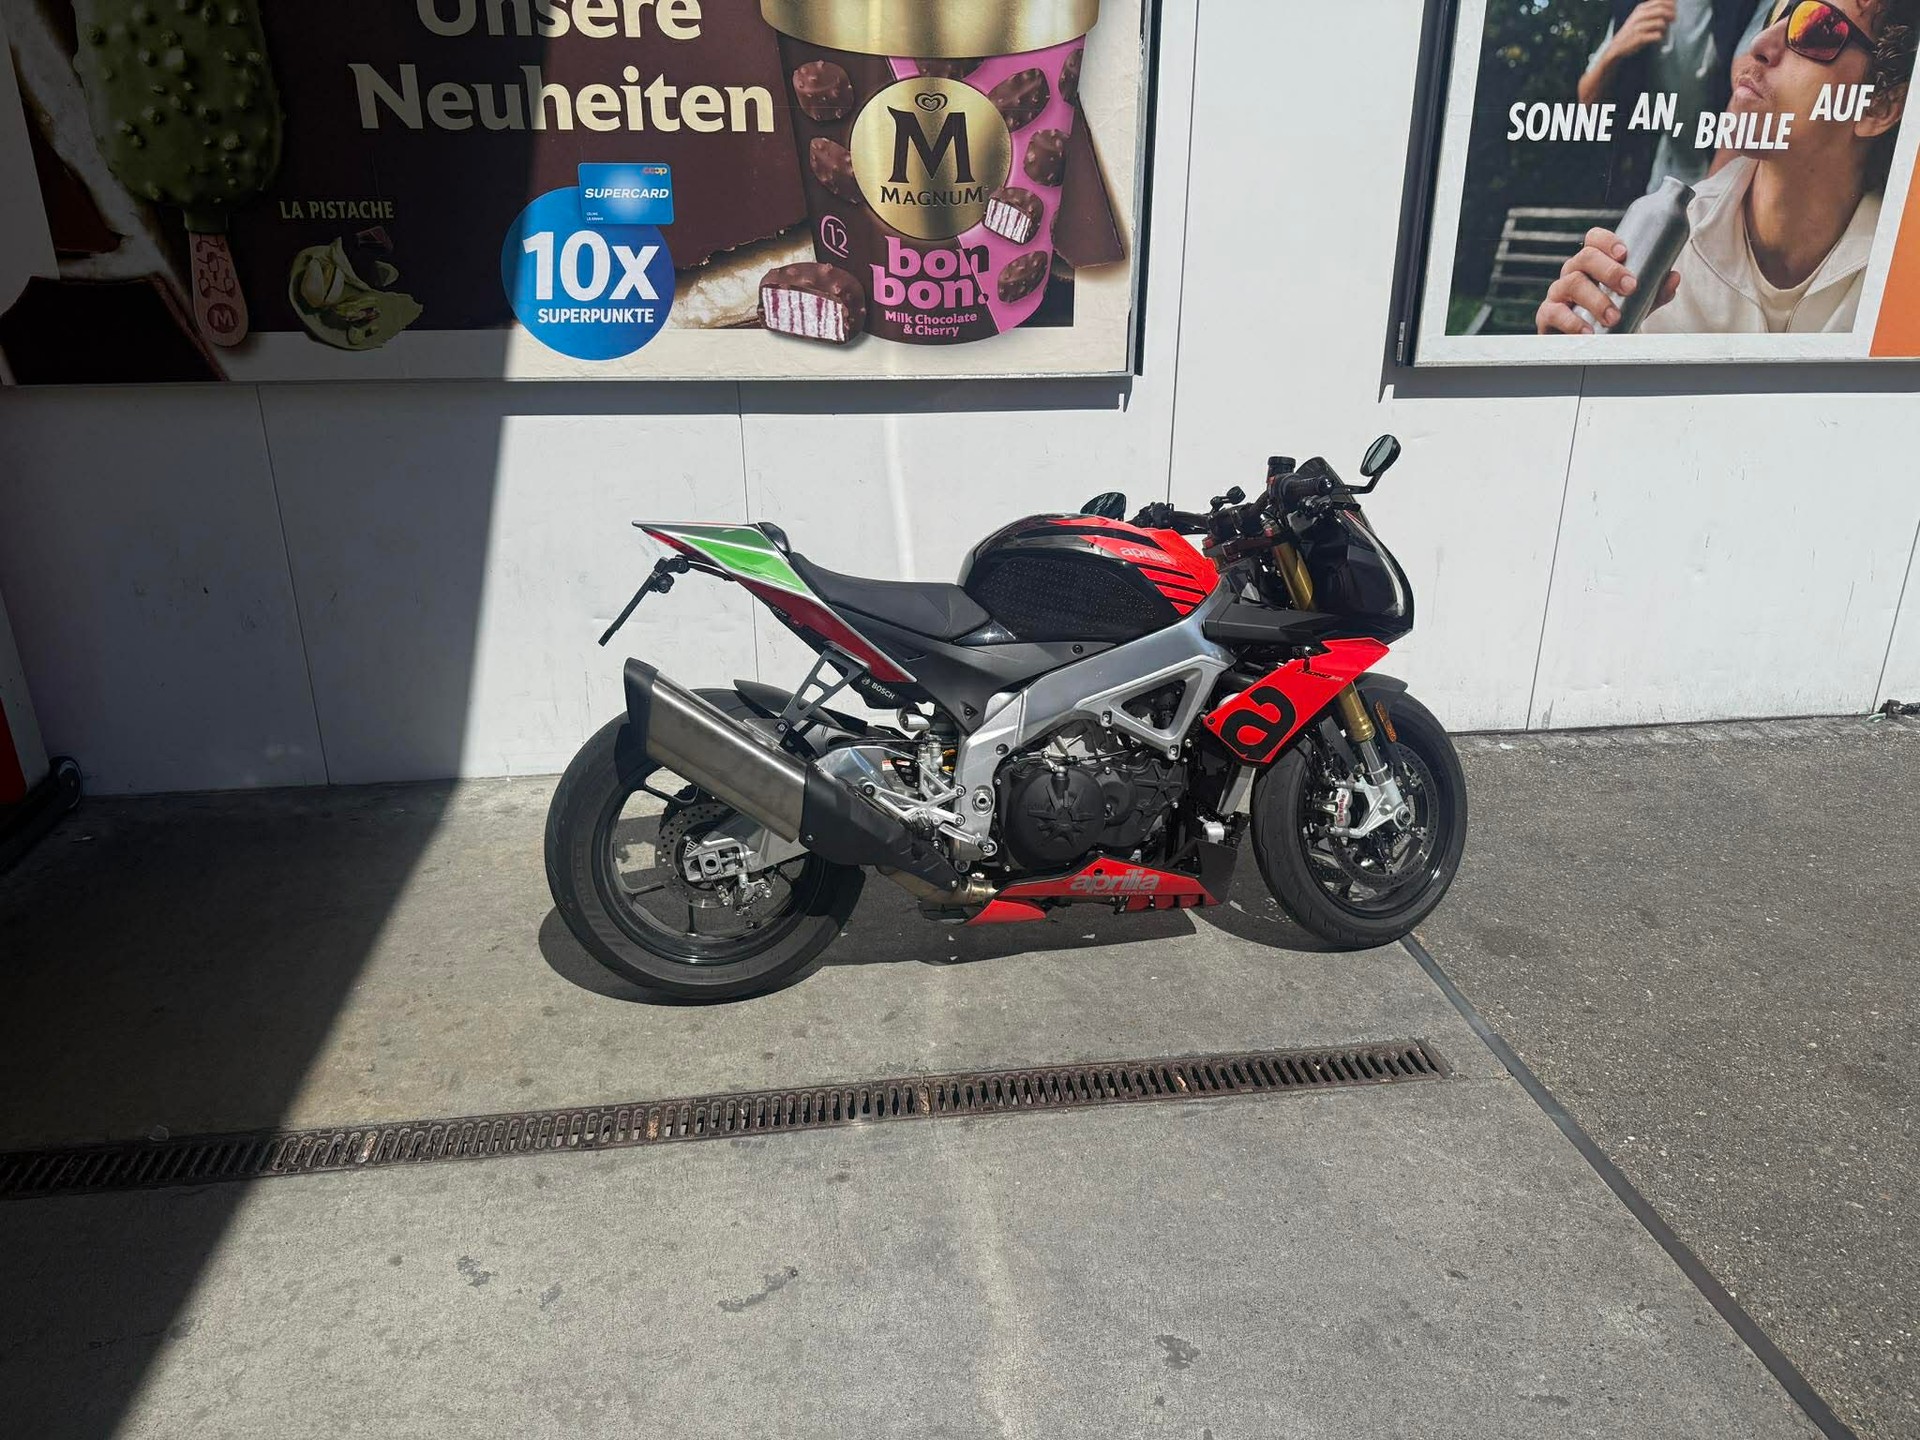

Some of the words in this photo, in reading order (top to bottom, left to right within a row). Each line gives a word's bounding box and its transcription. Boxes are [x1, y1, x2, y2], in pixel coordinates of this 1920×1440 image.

[417, 0, 702, 40] Unsere
[348, 63, 775, 132] Neuheiten
[1507, 102, 1616, 142] SONNE
[1627, 92, 1684, 138] AN,
[1694, 111, 1795, 150] BRILLE
[1809, 83, 1875, 122] AUF
[887, 105, 976, 184] M
[584, 188, 670, 199] SUPERCARD
[880, 185, 984, 206] MAGNUM
[279, 200, 304, 220] LA
[308, 200, 395, 220] PISTACHE
[522, 230, 660, 302] 10x
[885, 235, 990, 279] bon
[538, 308, 654, 323] SUPERPUNKTE
[885, 310, 912, 324] Milk
[915, 312, 978, 325] Chocolate
[903, 325, 913, 335] &
[914, 325, 960, 337] Cherry
[1120, 547, 1172, 565] aprilia
[871, 682, 896, 700] BOSCH
[1070, 868, 1160, 893] aprilia
